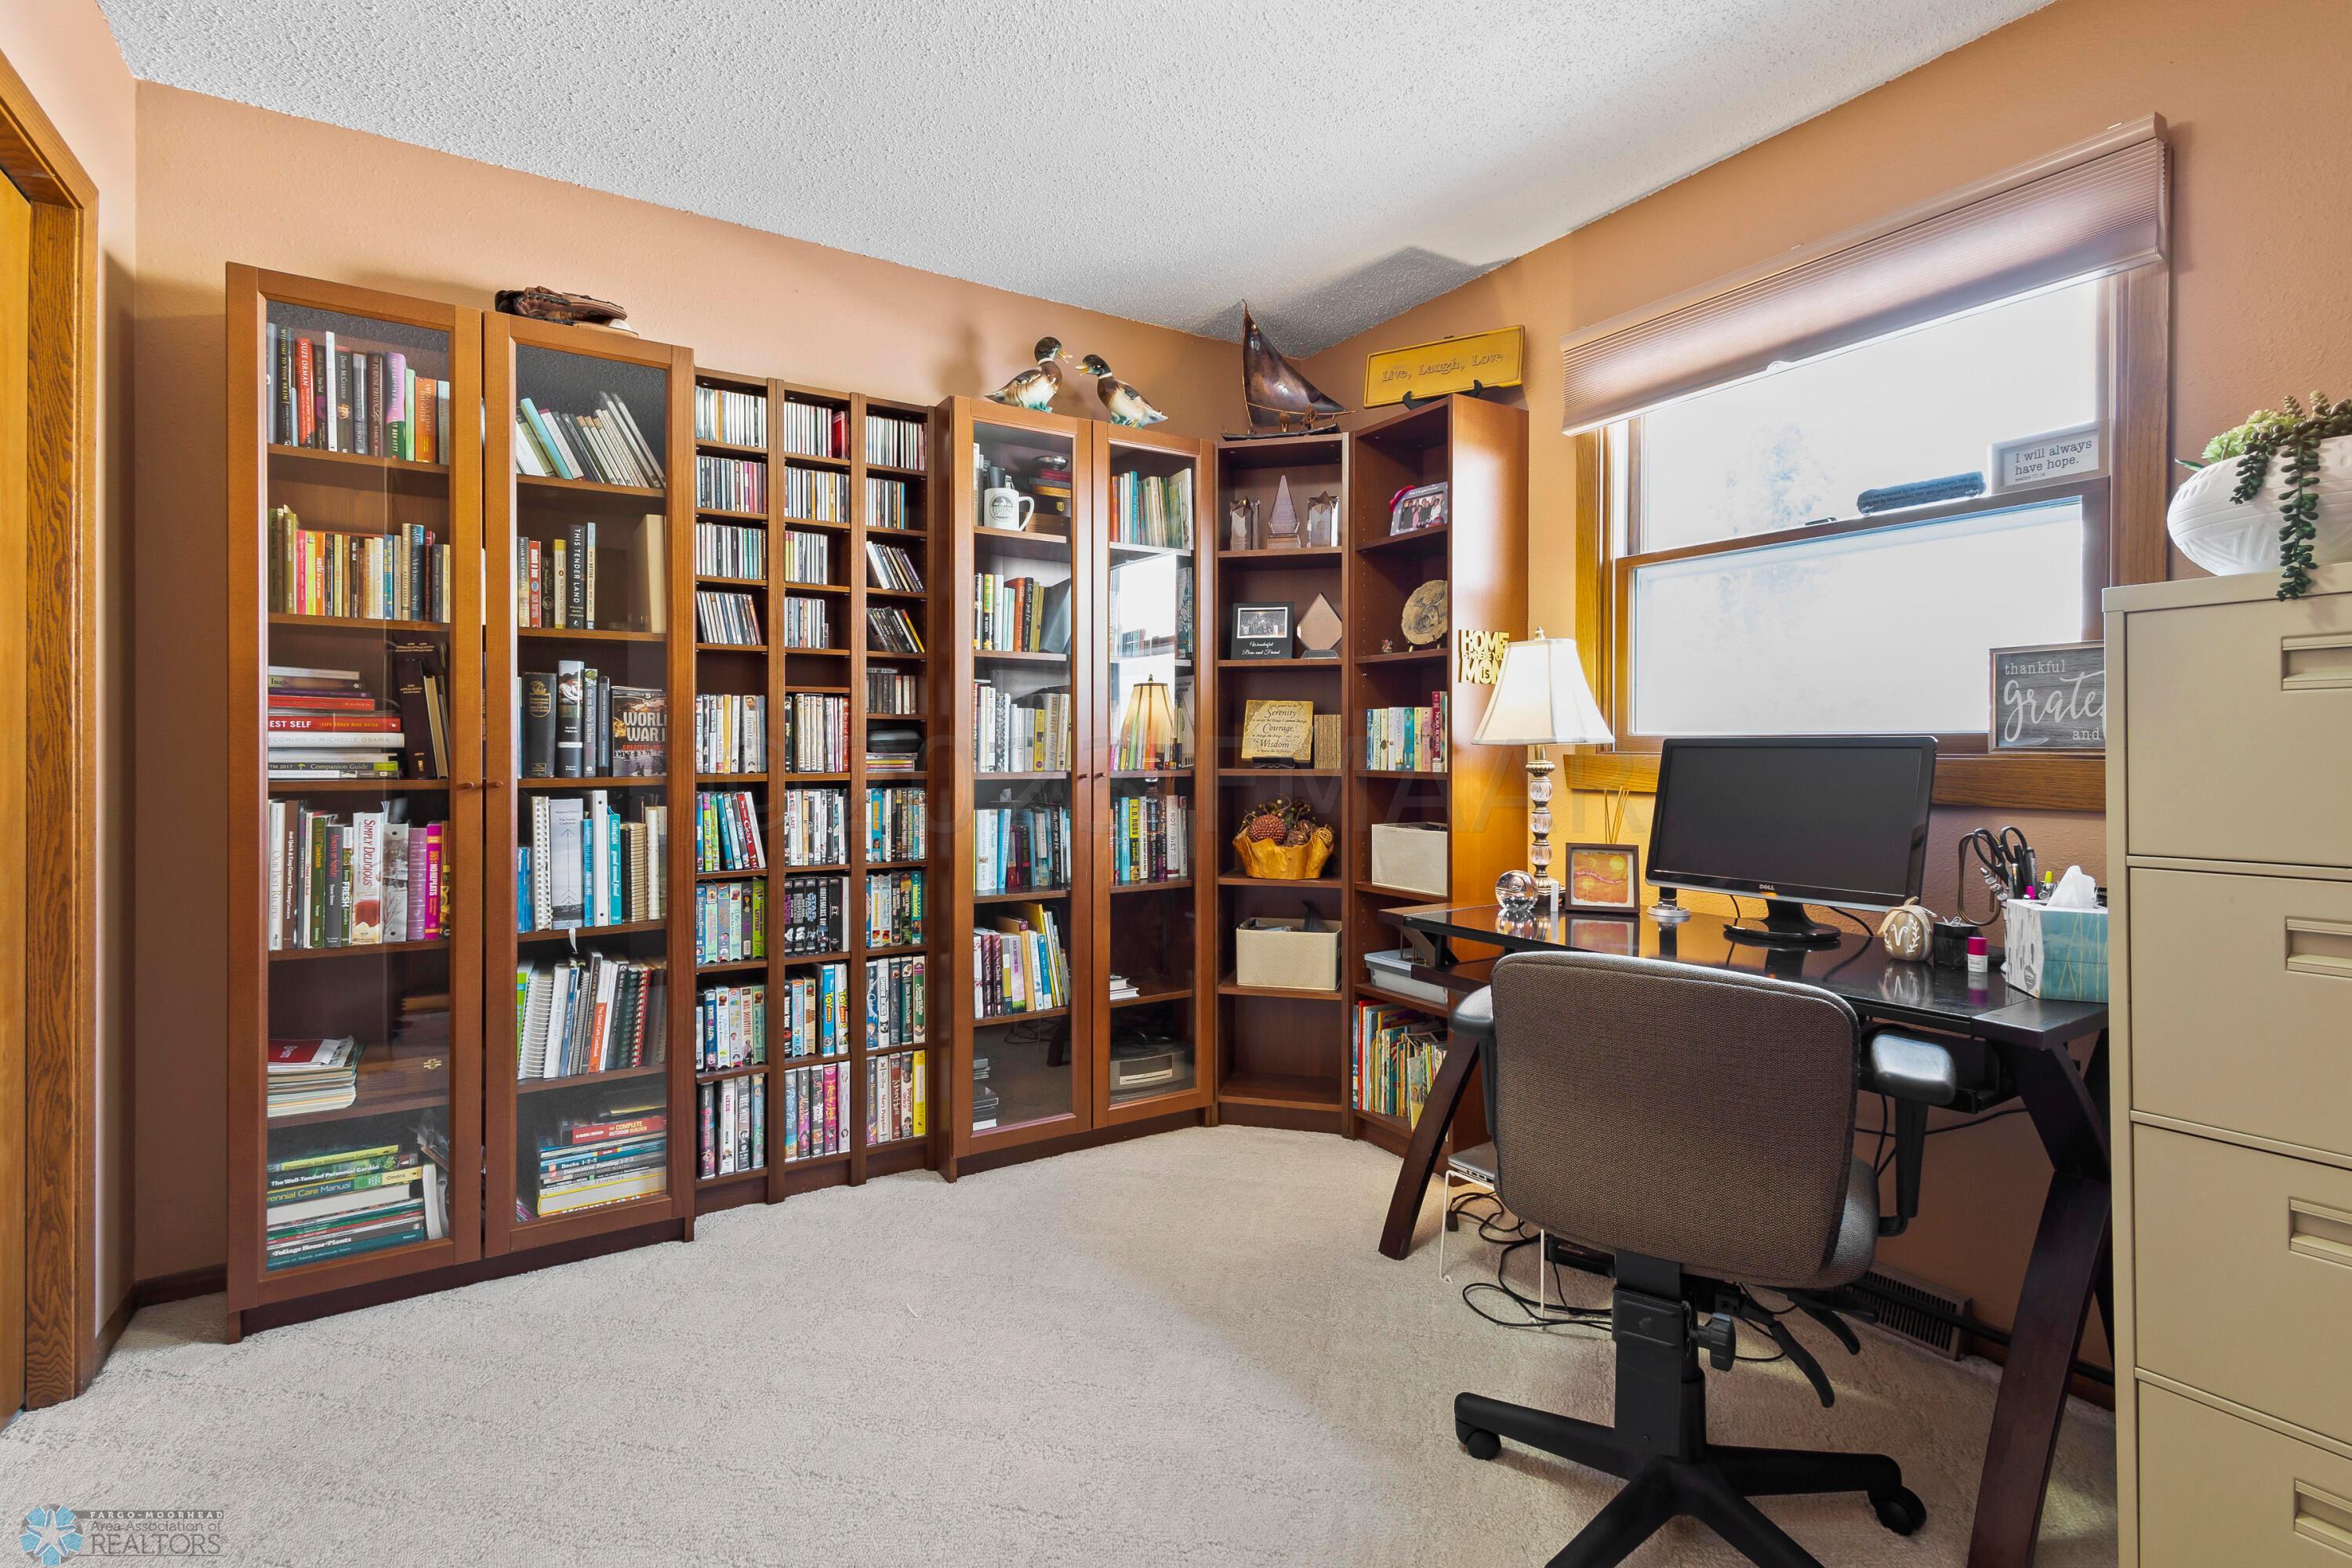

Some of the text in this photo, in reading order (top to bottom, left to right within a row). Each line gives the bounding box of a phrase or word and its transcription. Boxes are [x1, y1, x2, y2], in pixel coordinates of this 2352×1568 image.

[1418, 358, 1465, 376] Laugh,
[1472, 354, 1504, 367] Love
[2015, 440, 2092, 463] I will always
[2015, 456, 2079, 476] have hope.
[2005, 660, 2068, 675] thankful
[586, 706, 594, 723] family
[1264, 708, 1298, 718] Serenity
[2004, 670, 2105, 742] grate
[626, 727, 660, 742] WAR
[1259, 739, 1290, 749] Wisdom
[2072, 728, 2101, 741] and
[310, 763, 347, 771] Companion
[743, 819, 753, 844] Cars
[363, 847, 376, 886] DELICIOUS
[342, 881, 350, 907] FRESH
[612, 882, 620, 897] food
[272, 891, 282, 920] RECIPES
[839, 989, 848, 1007] TOY
[739, 1094, 749, 1123] FREE WILLY
[786, 1088, 796, 1129] Peter Pan
[799, 1092, 809, 1123] Aladdin
[615, 1120, 643, 1131] COMPLETE
[284, 1174, 325, 1185] Well-Tended
[325, 1168, 356, 1178] Perennial
[356, 1165, 380, 1174] Garden
[564, 1165, 595, 1175] Decorative
[596, 1160, 619, 1170] Painting
[267, 1181, 351, 1202] rennial Care Manual
[272, 1237, 351, 1257] Foliage House Plants
